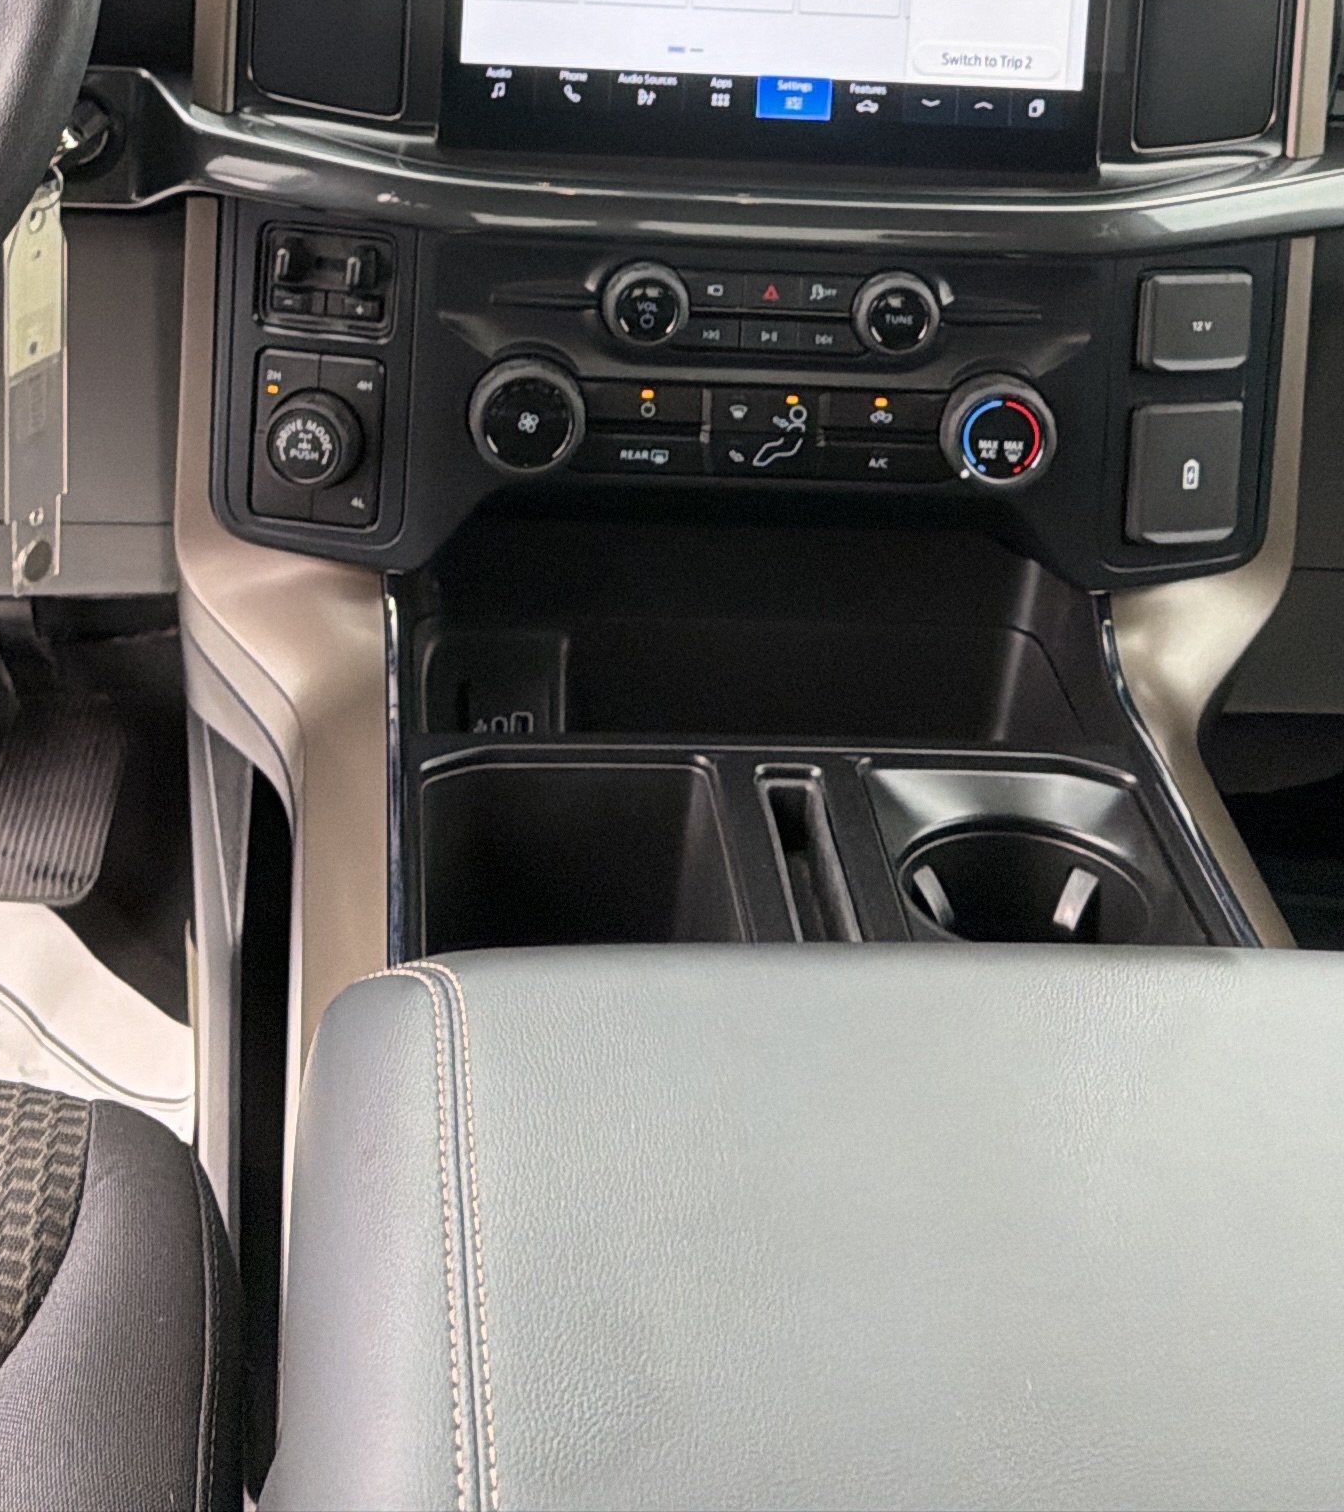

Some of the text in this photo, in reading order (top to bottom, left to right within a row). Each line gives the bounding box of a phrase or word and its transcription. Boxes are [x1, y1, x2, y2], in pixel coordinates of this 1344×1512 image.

[941, 52, 1033, 71] Switch to Trip 2
[485, 67, 512, 80] Audio
[559, 70, 588, 83] Phone
[617, 72, 678, 87] Audio Sources
[710, 77, 733, 91] Apps
[776, 79, 813, 94] Settings
[849, 82, 887, 96] Features
[637, 300, 658, 314] VOL
[885, 314, 914, 326] TUNE
[1192, 321, 1204, 332] 12
[266, 369, 282, 381] 2H
[275, 418, 333, 451] DRIVE MODE
[977, 439, 1024, 451] MAX MAX
[289, 447, 320, 461] PUSH
[619, 449, 649, 462] REAR
[979, 449, 998, 460] A/C
[868, 456, 888, 470] A/C
